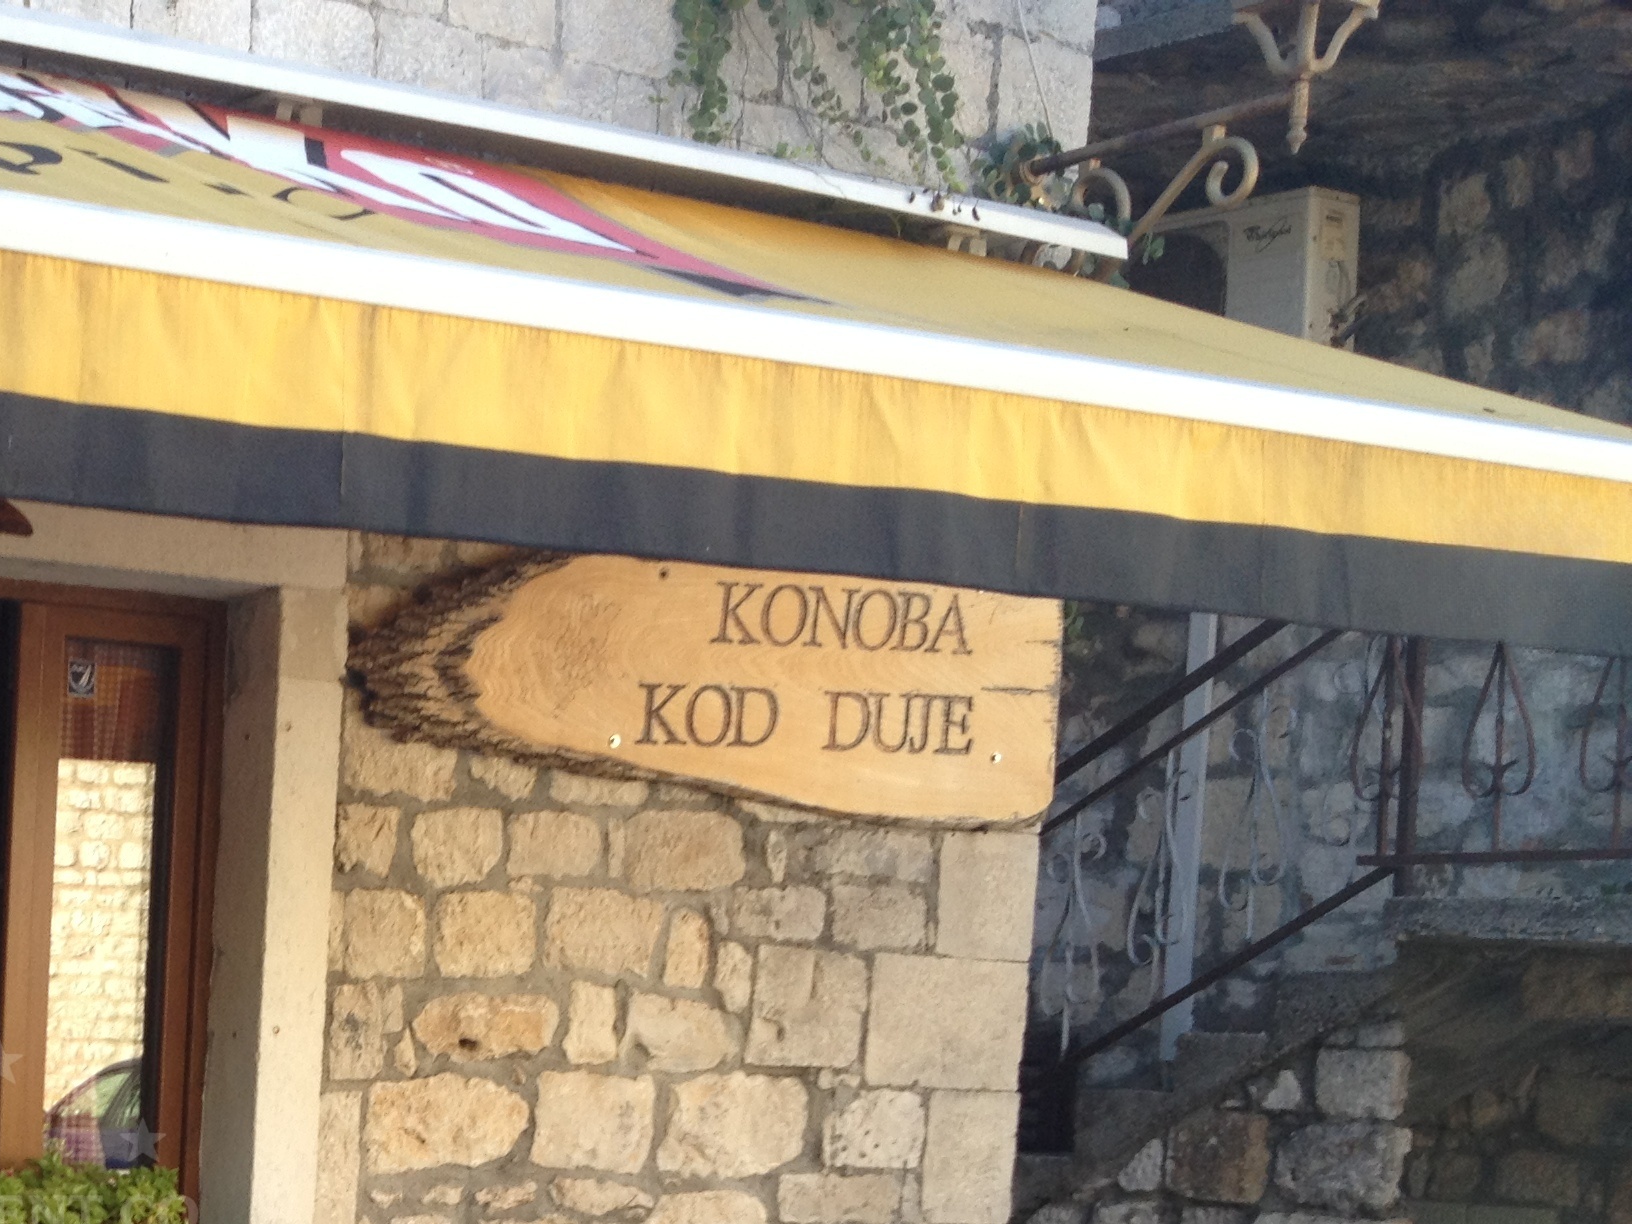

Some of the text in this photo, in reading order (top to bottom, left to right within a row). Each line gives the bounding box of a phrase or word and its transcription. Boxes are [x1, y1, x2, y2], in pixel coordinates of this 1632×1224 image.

[710, 581, 973, 656] KONOBA
[634, 682, 974, 755] KOD DUJE
